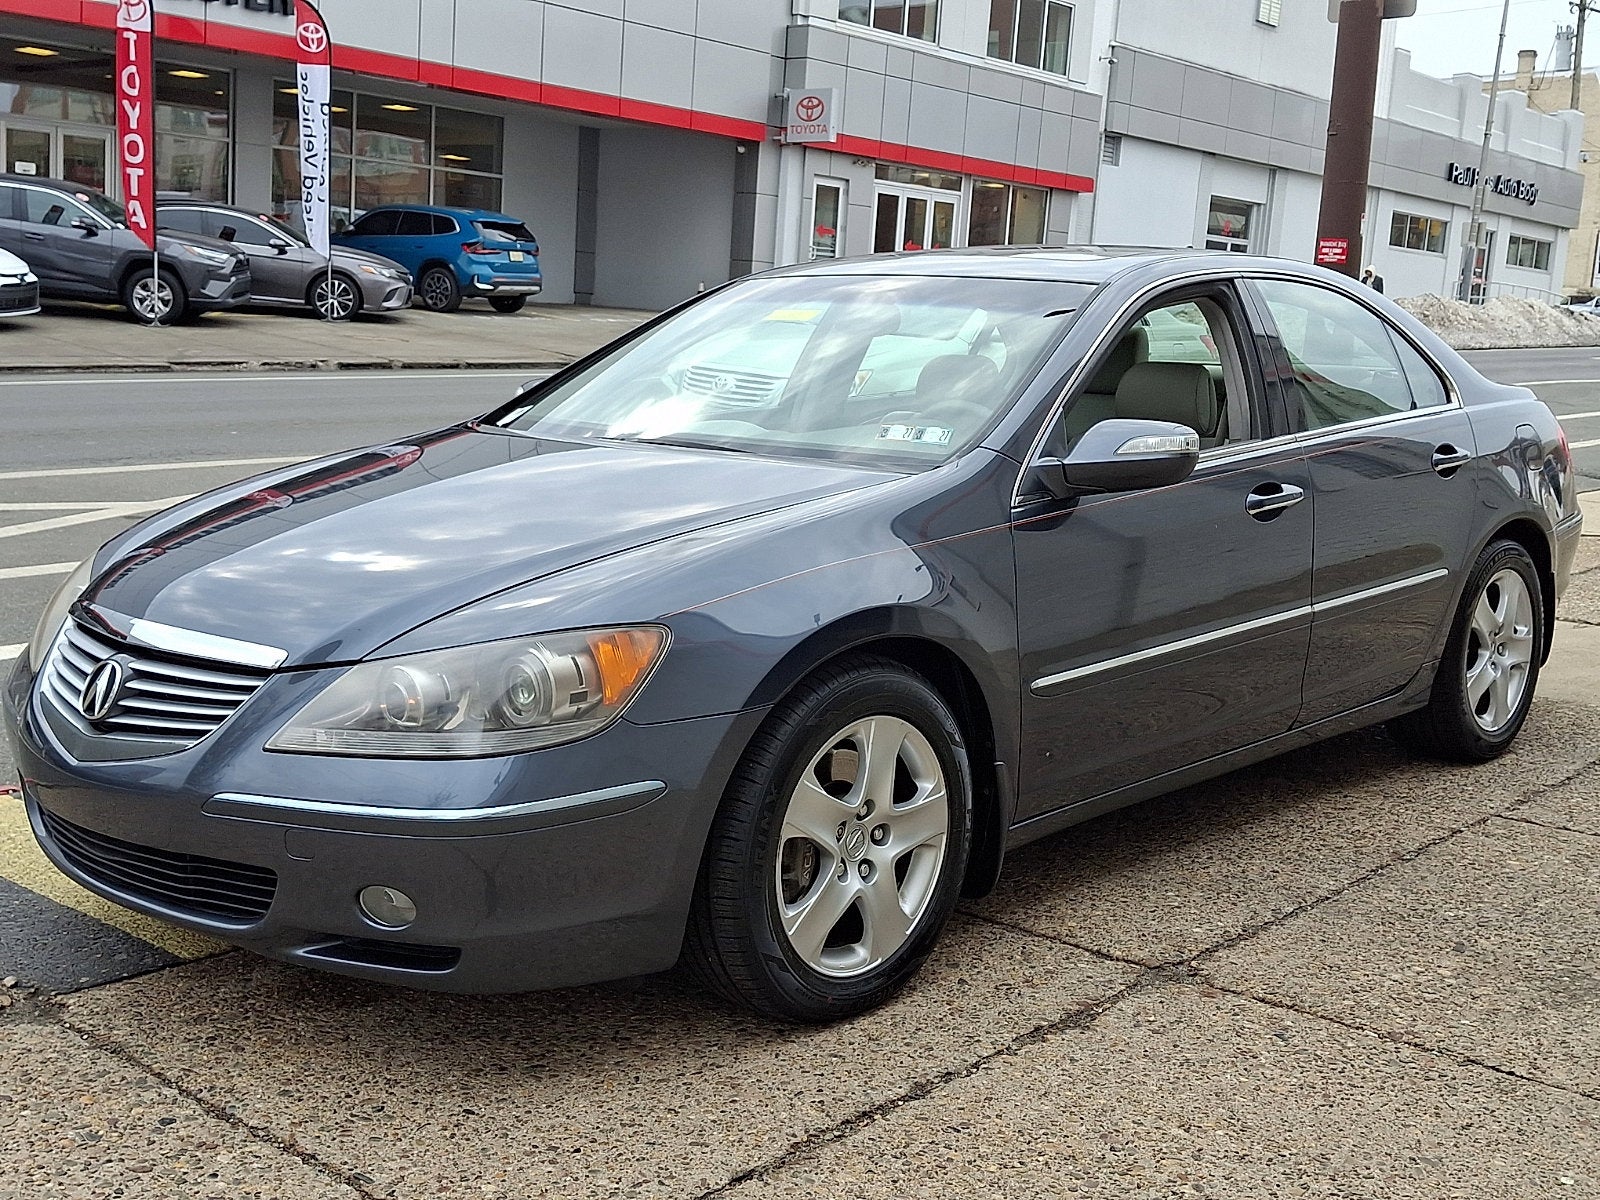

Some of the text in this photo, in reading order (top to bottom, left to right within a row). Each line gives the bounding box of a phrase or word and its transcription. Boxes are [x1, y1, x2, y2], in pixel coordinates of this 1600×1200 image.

[121, 31, 147, 229] TOYOTA
[790, 124, 828, 134] TOYOTA
[1448, 161, 1474, 187] Paul
[1495, 173, 1518, 197] Auto
[1517, 180, 1540, 207] Body
